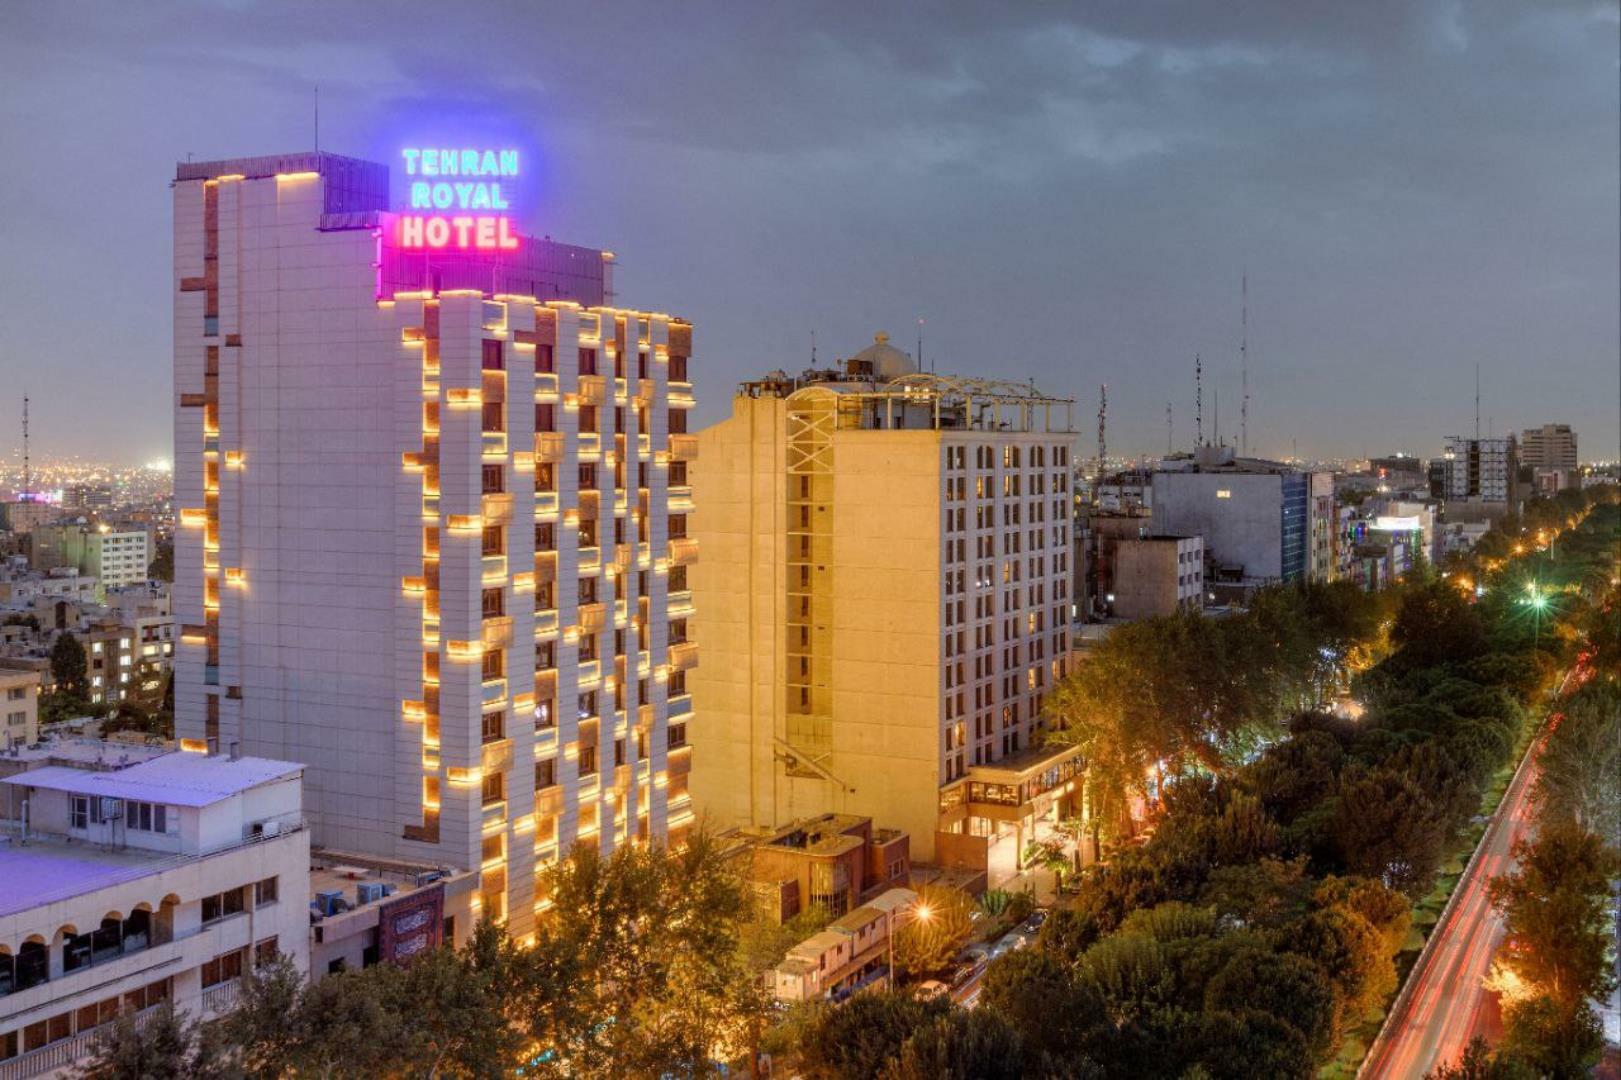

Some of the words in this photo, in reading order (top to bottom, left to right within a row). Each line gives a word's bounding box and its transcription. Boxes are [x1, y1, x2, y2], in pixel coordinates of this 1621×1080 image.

[402, 149, 518, 175] TEHRAN
[411, 182, 508, 209] ROYAL
[402, 216, 518, 248] HOTEL
